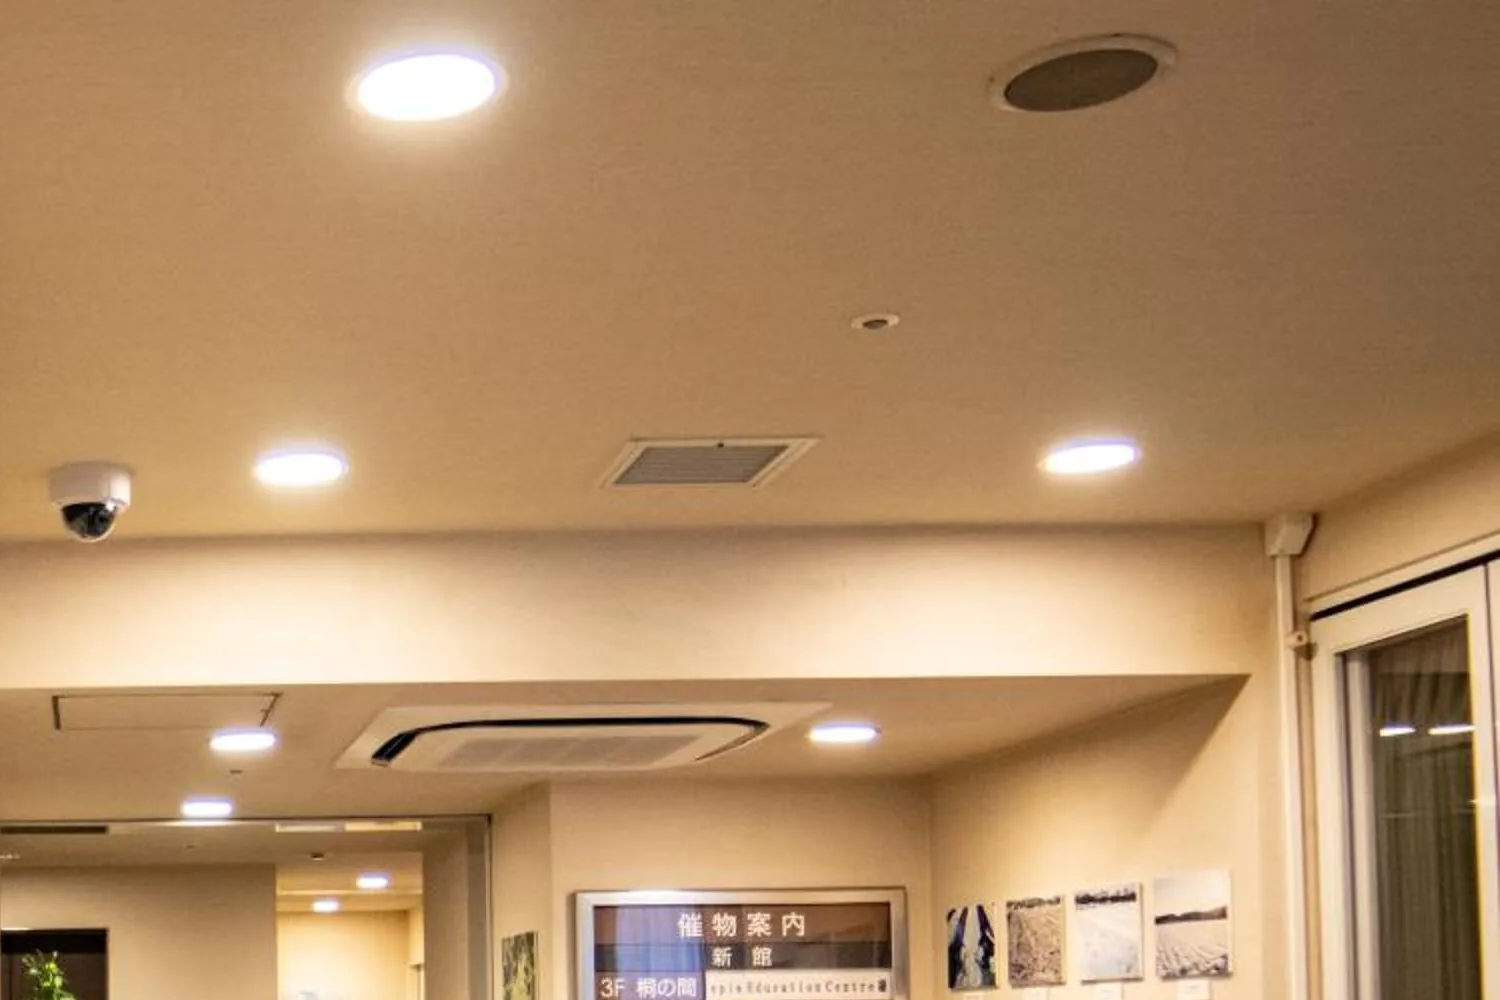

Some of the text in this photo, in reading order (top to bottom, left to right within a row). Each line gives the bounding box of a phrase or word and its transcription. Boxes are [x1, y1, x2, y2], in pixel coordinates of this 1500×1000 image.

[677, 912, 805, 937] 催物案内
[711, 946, 773, 967] 新館
[601, 978, 625, 998] 3F
